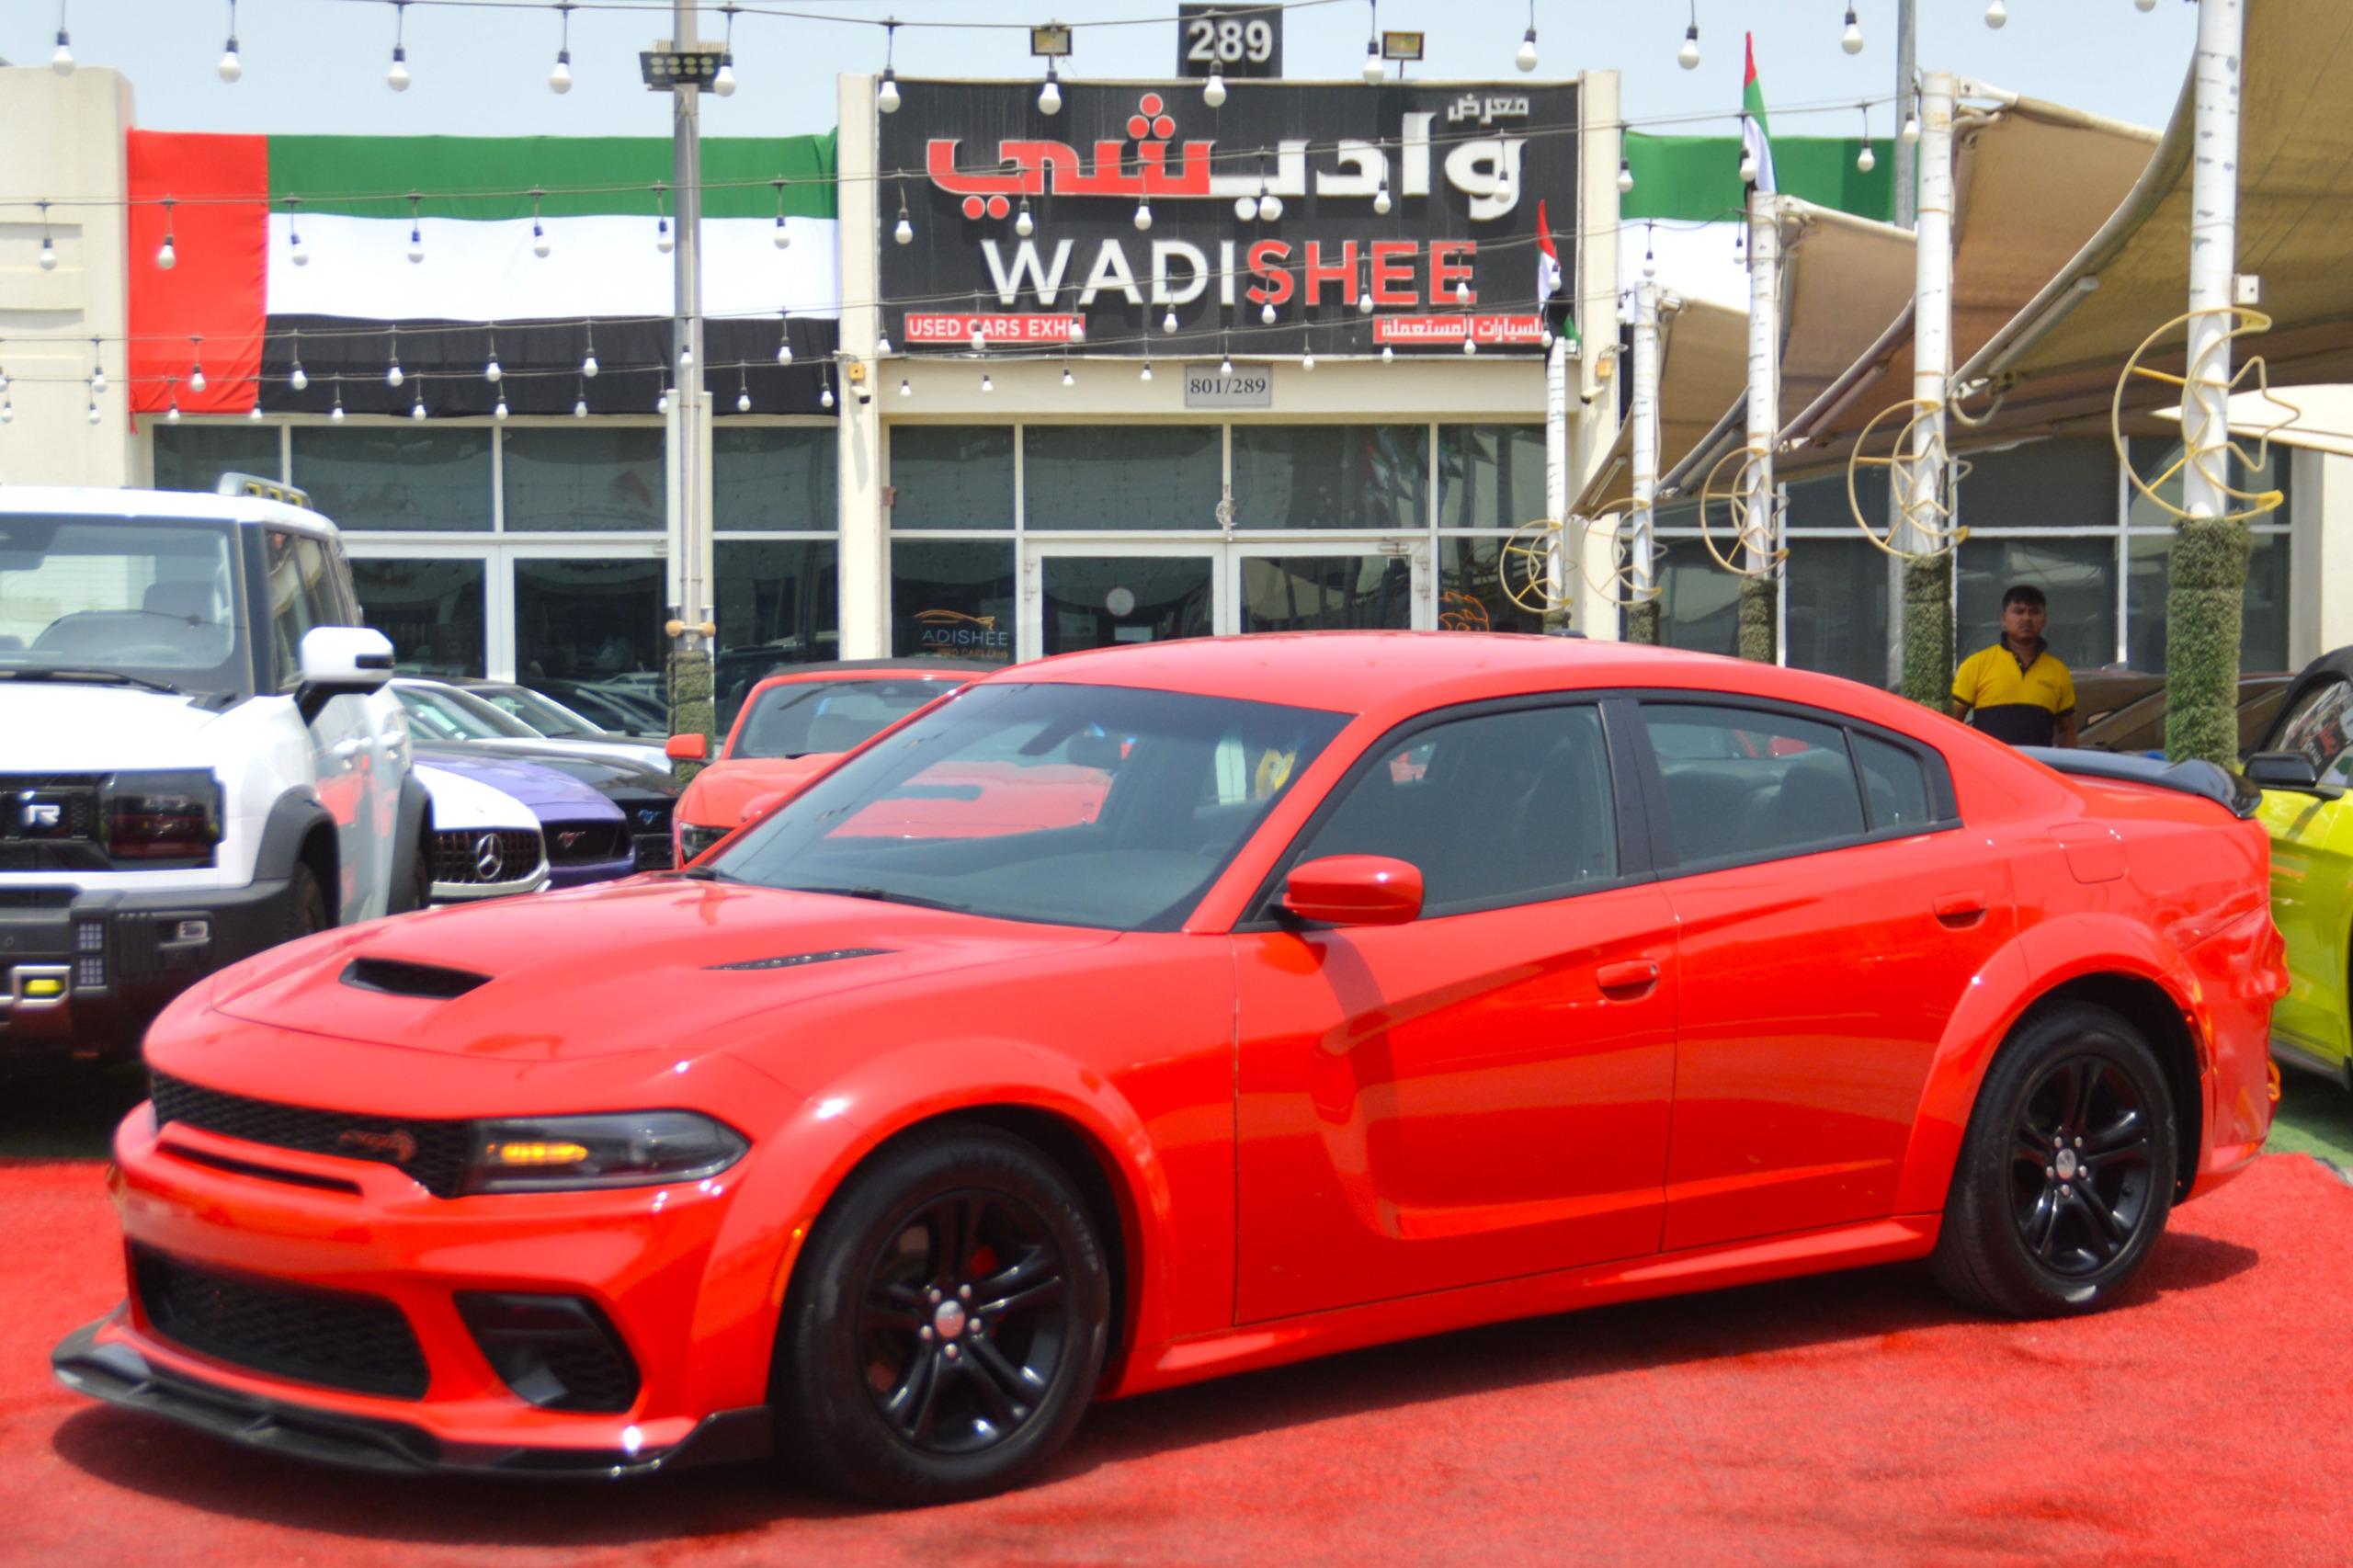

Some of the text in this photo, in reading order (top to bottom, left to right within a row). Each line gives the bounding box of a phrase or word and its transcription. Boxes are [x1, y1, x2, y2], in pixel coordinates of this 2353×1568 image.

[1188, 18, 1272, 63] 289
[1448, 93, 1529, 124] معرض
[980, 239, 1477, 306] WADISHEE
[909, 318, 961, 336] USED
[967, 318, 1020, 336] CARS
[1190, 378, 1267, 394] 801/289
